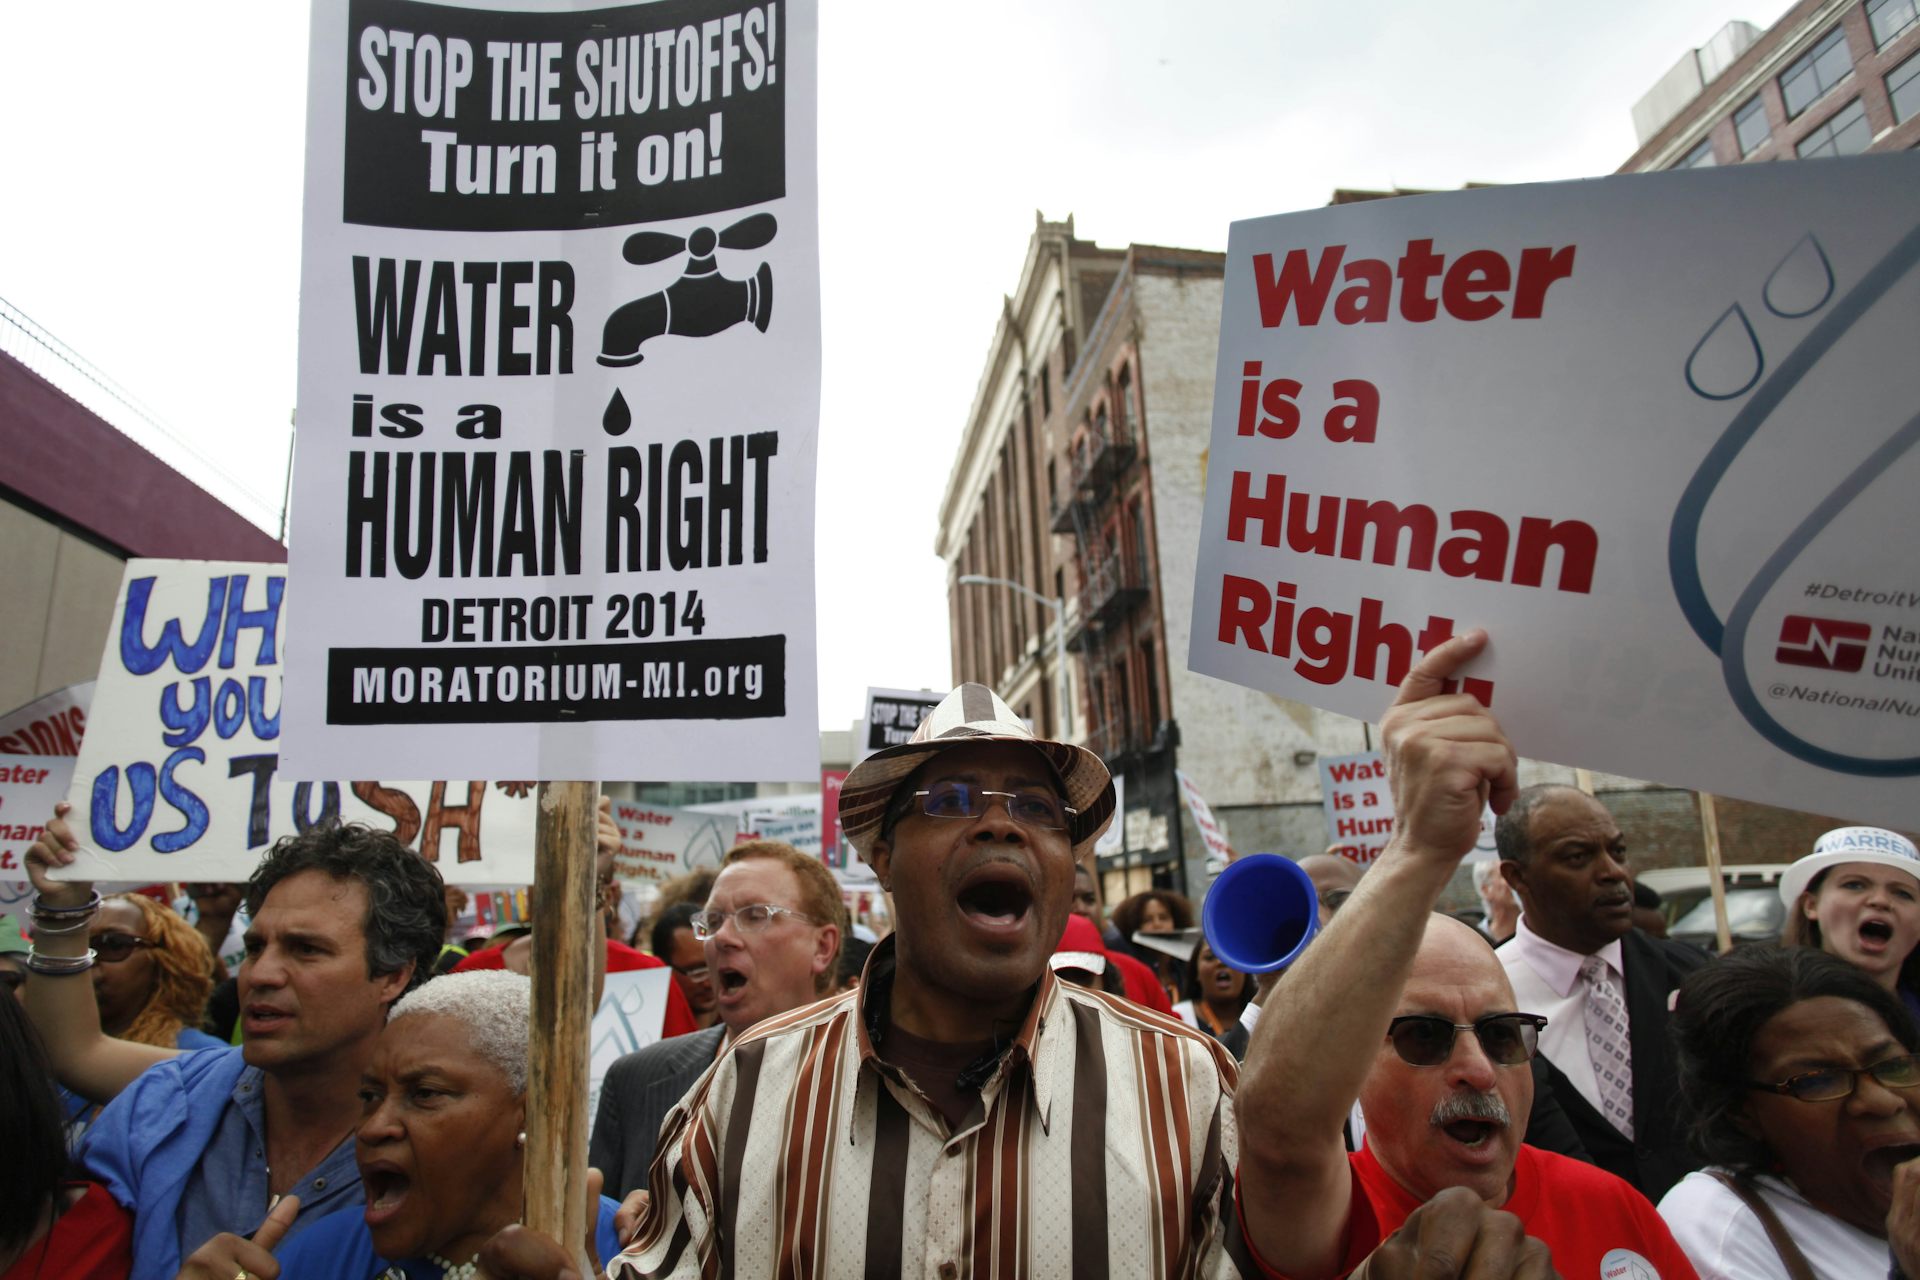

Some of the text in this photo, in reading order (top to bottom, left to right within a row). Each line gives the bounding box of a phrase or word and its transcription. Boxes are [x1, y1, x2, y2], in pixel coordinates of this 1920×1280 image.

[358, 2, 777, 122] STOP THE SHUTOFFS!
[421, 112, 723, 195] Turn it on!
[352, 255, 576, 377] WATER
[1252, 237, 1577, 329] Water
[352, 394, 502, 440] is a
[1237, 360, 1381, 444] is a
[345, 431, 778, 580] HUMAN RIGHT
[1226, 469, 1599, 595] Human
[120, 574, 286, 676] WH
[422, 590, 705, 643] DETROIT 2014
[1882, 624, 1920, 646] Na
[352, 661, 764, 704] MORATORIUM-MI.org
[91, 745, 210, 853] US
[617, 805, 674, 827] Water
[1332, 791, 1379, 811] is a
[1825, 834, 1916, 859] WARREN
